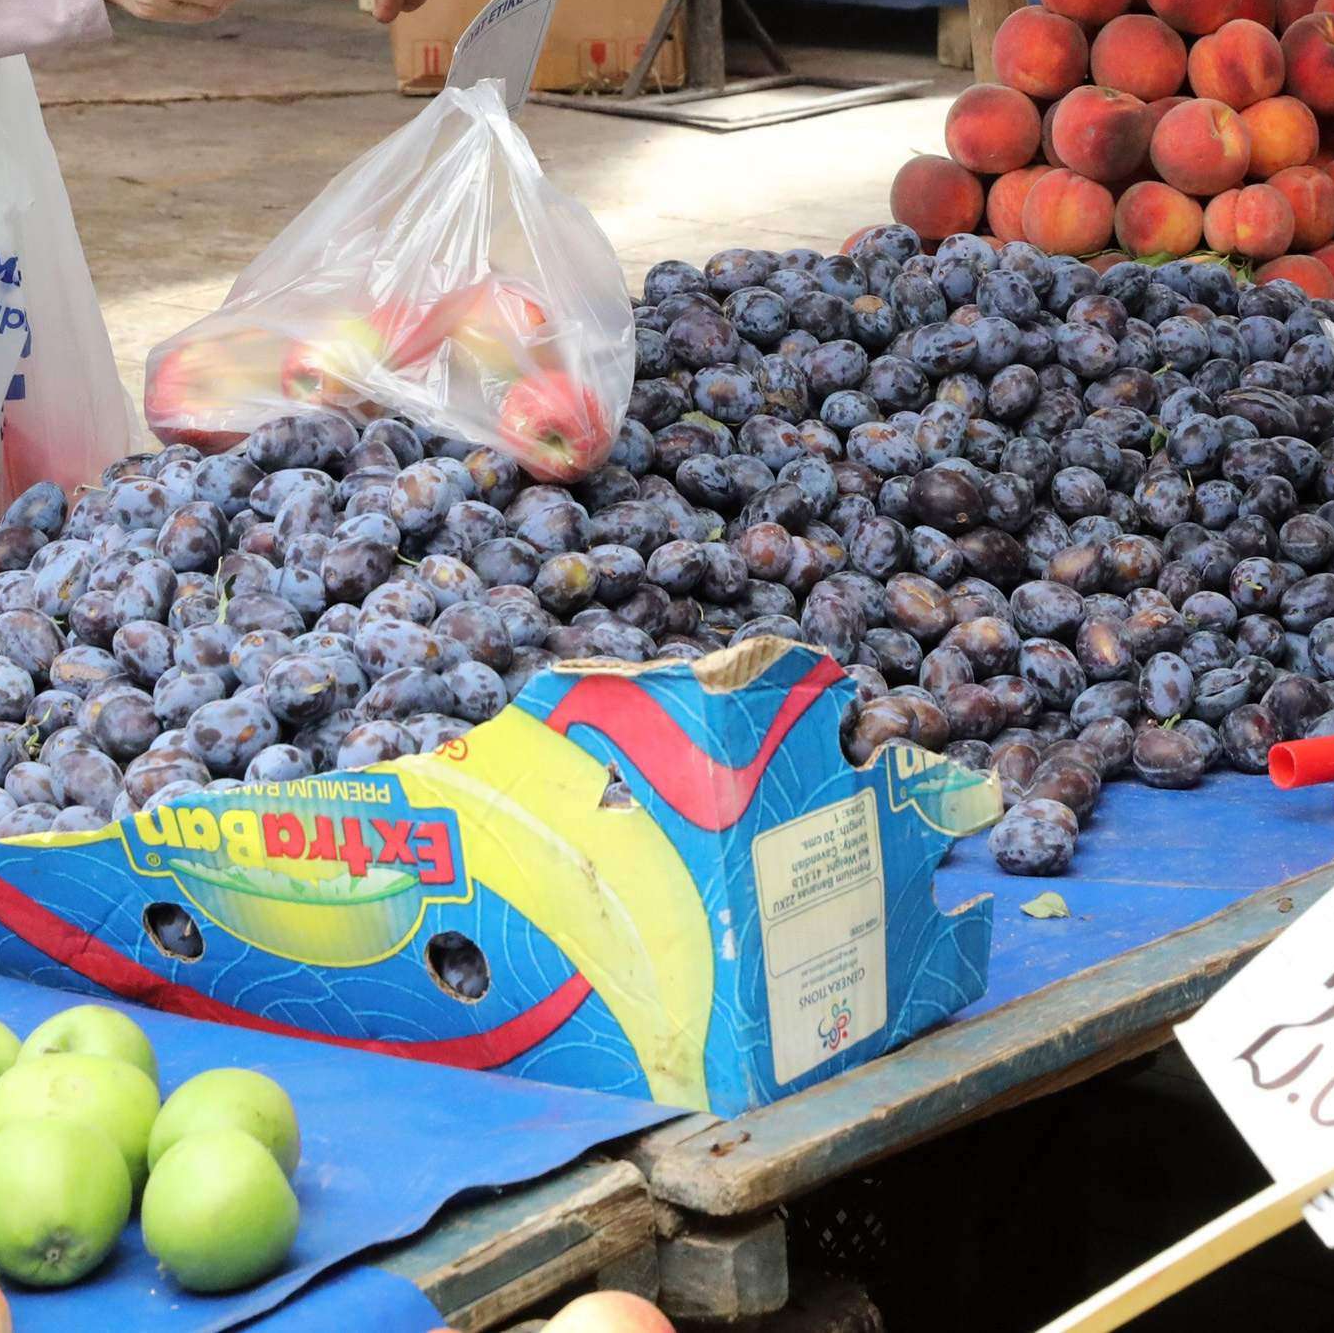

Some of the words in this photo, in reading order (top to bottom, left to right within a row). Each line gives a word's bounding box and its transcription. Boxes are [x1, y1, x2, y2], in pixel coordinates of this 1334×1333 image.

[287, 777, 391, 804] PREMIUM
[134, 804, 456, 885] ExtraBan
[791, 846, 838, 873] Cavendish
[798, 967, 866, 1011] GENERATIONS
